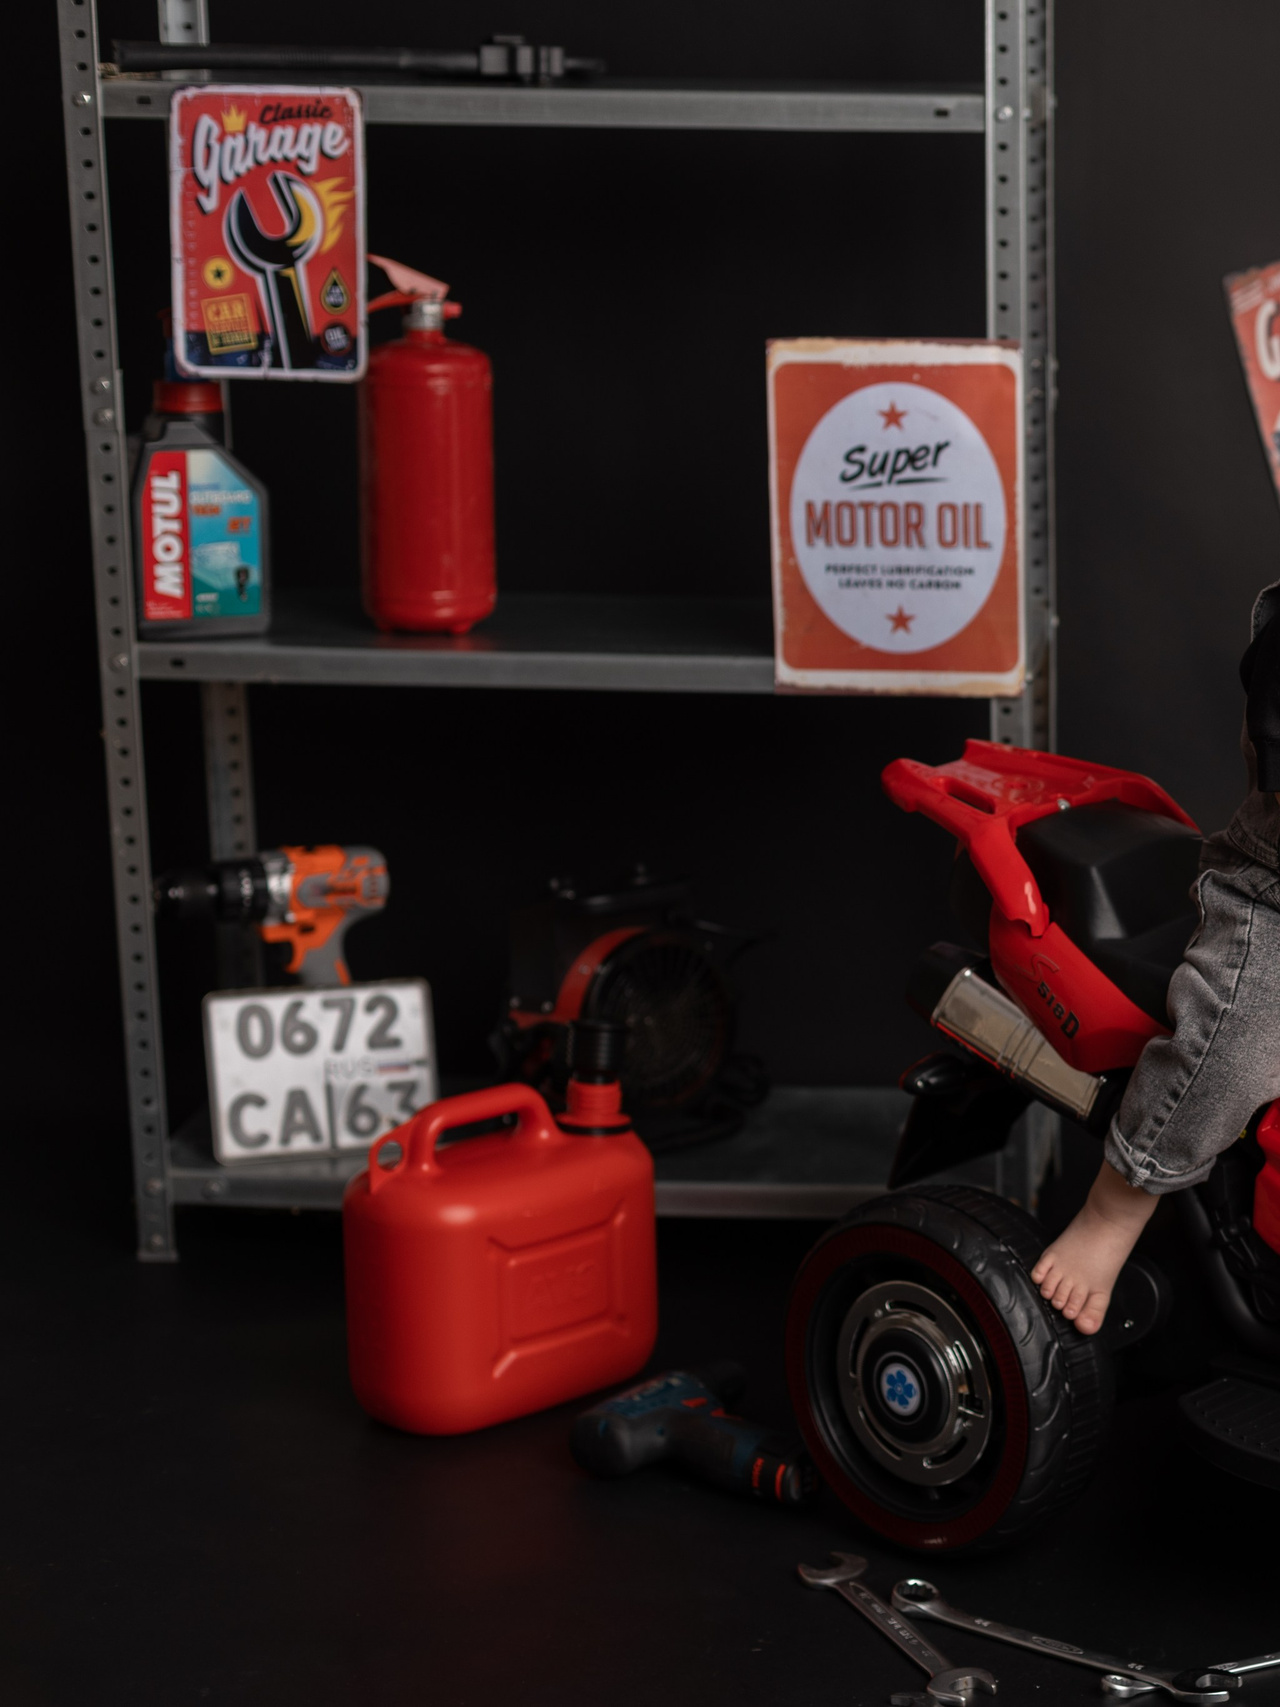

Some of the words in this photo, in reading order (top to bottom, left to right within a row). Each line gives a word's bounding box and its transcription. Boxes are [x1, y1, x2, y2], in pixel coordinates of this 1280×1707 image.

[260, 100, 333, 125] Classic
[192, 113, 349, 215] Garage
[839, 440, 951, 485] Super
[151, 470, 185, 599] MOTUL
[805, 500, 927, 549] MOTOR
[937, 502, 993, 550] OIL
[825, 563, 877, 575] PERFECT
[880, 564, 975, 577] LUBRIFICATION
[838, 578, 882, 590] LEAVES
[886, 579, 905, 590] NO
[909, 579, 962, 590] CARBON
[236, 994, 402, 1060] 0672
[228, 1088, 322, 1150] CA
